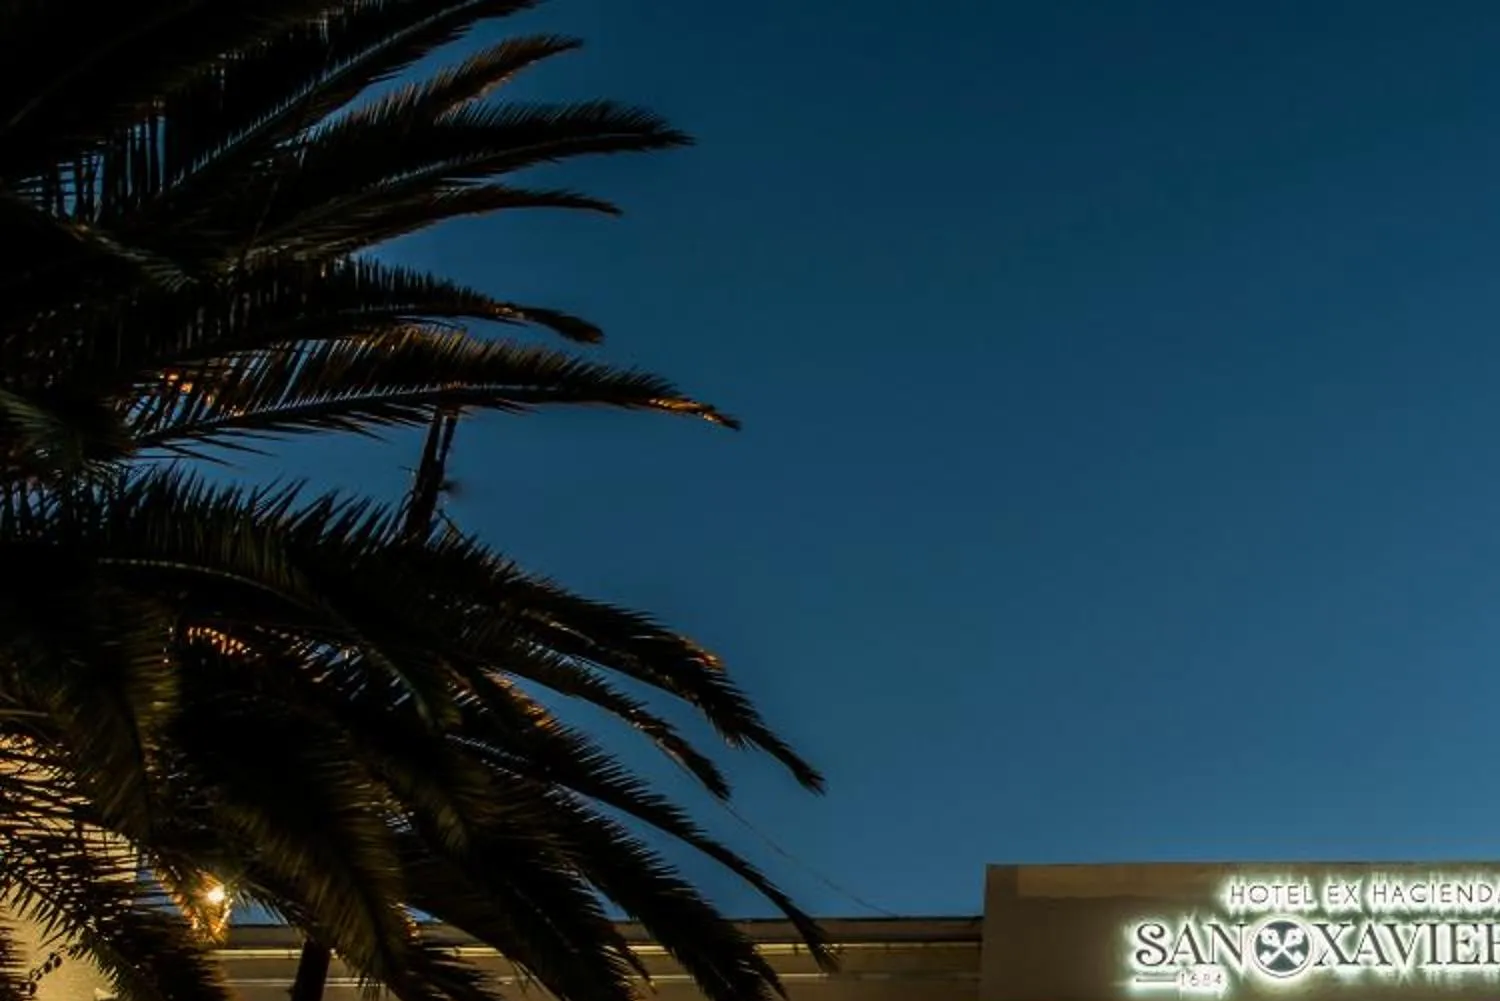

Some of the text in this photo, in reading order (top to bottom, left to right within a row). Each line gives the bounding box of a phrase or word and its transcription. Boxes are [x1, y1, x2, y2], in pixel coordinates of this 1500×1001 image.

[1230, 884, 1315, 904] HOTEL
[1327, 884, 1360, 904] EX
[1136, 922, 1249, 967] SAN
